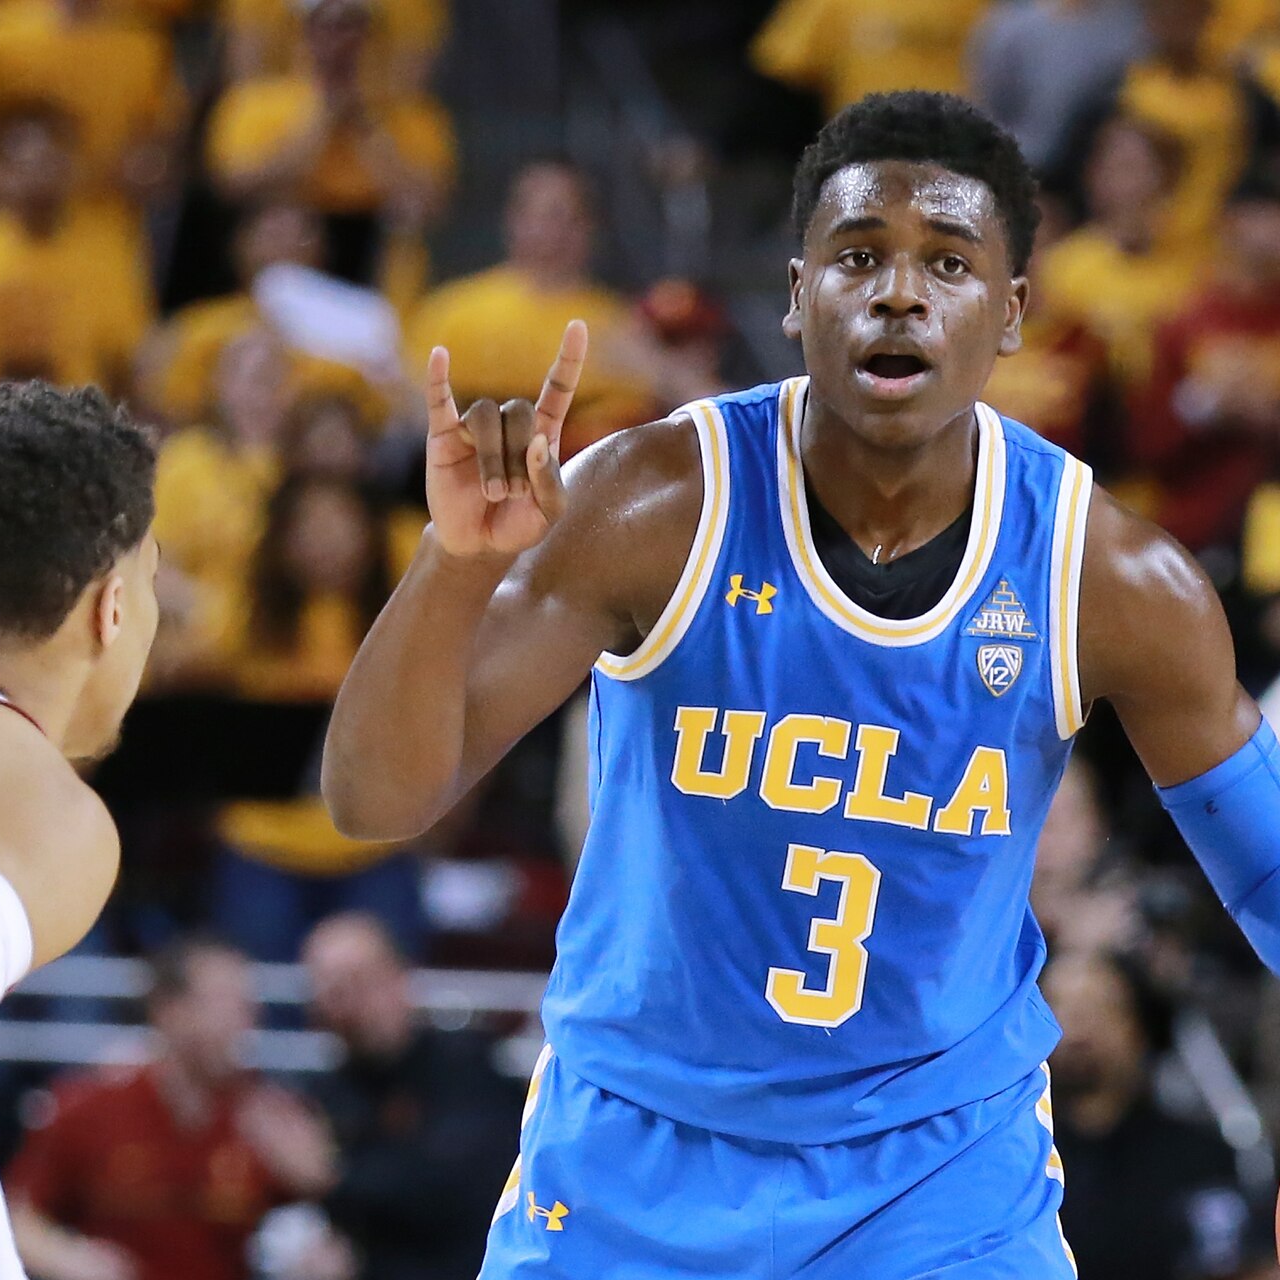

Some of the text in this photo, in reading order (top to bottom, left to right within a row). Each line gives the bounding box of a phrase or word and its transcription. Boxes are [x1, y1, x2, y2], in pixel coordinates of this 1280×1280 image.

[976, 611, 1026, 633] JRW
[980, 646, 1020, 677] PAC
[989, 666, 1009, 686] 12
[671, 705, 1013, 837] UCLA
[764, 843, 882, 1028] 3
